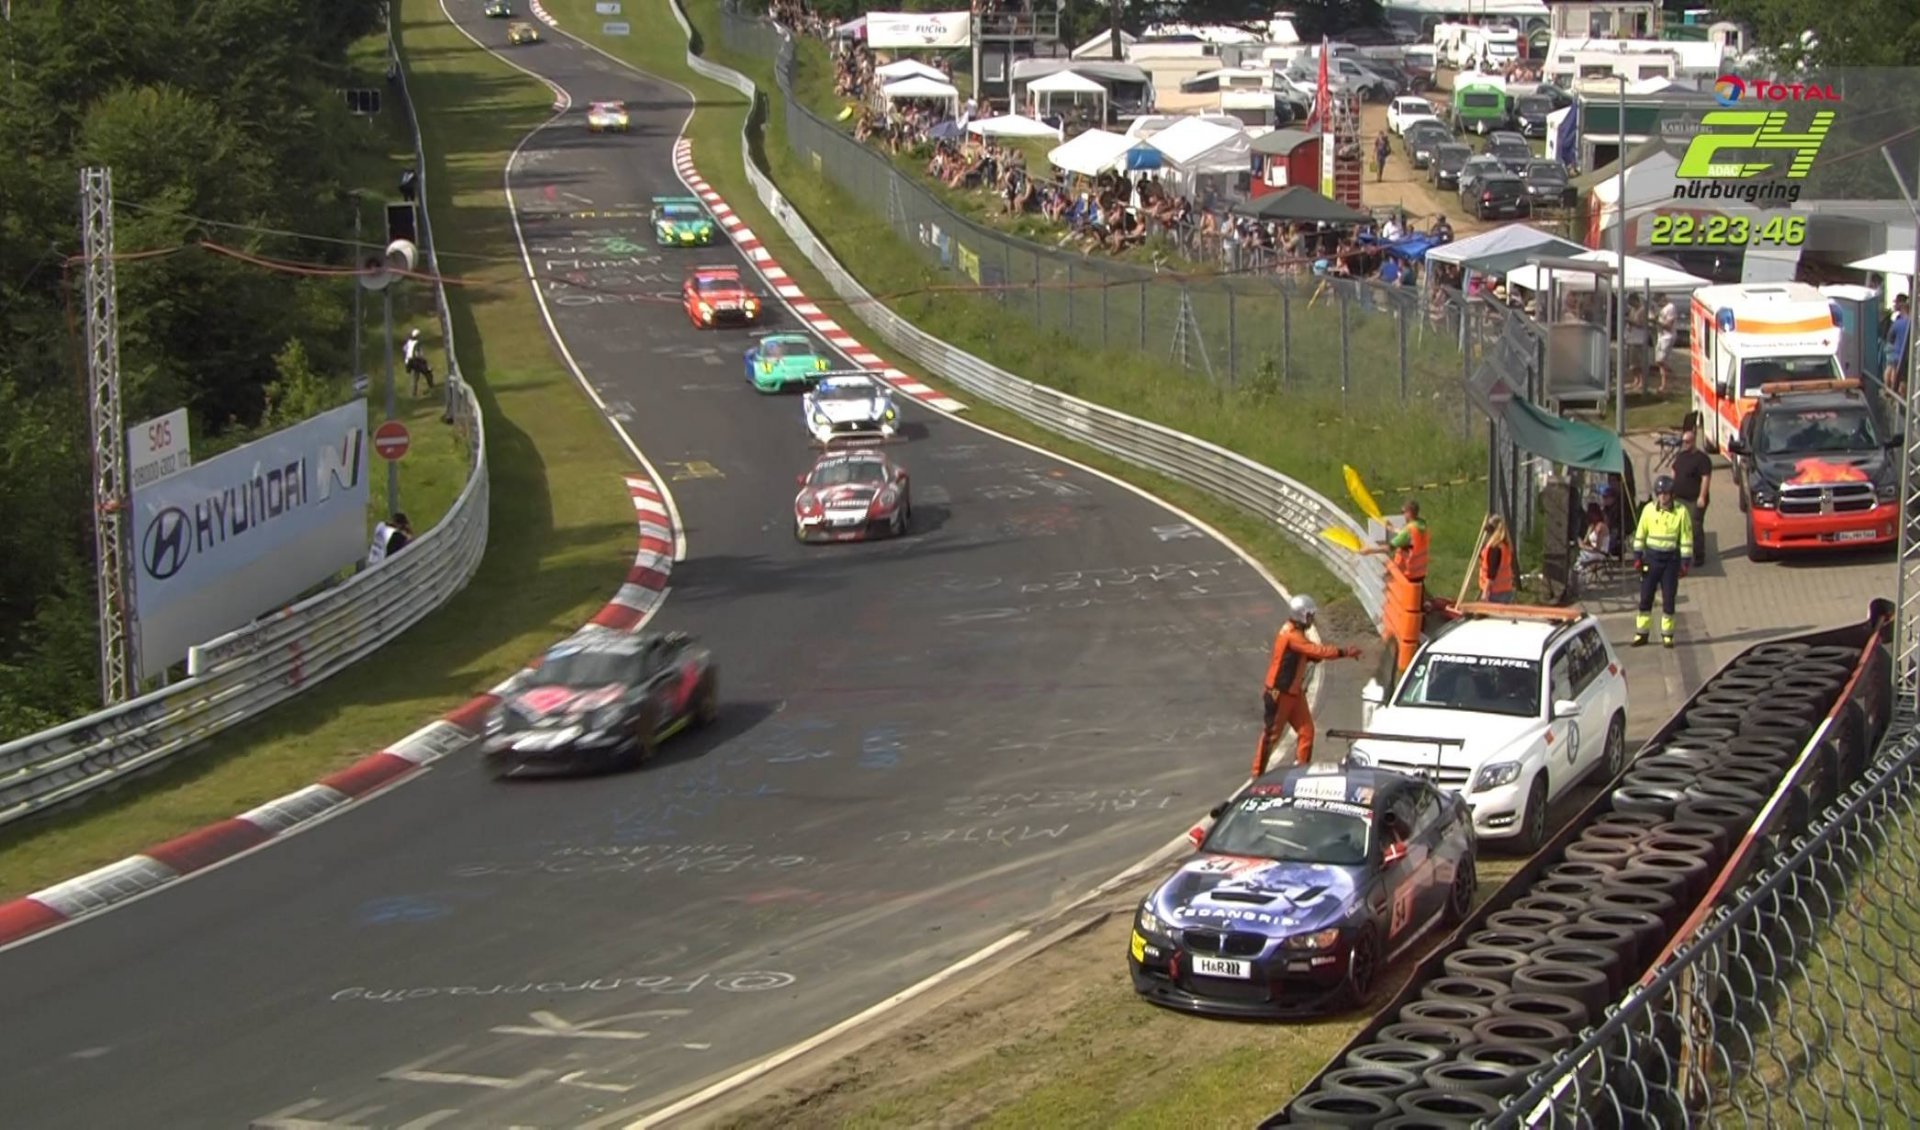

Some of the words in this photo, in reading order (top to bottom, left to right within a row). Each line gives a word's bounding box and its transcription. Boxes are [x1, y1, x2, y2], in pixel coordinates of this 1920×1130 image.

[915, 25, 947, 34] FUCHS
[149, 420, 172, 451] SOS
[195, 457, 308, 553] HYUNDAI
[1480, 658, 1531, 669] STAFFEL
[1201, 960, 1225, 972] H&R
